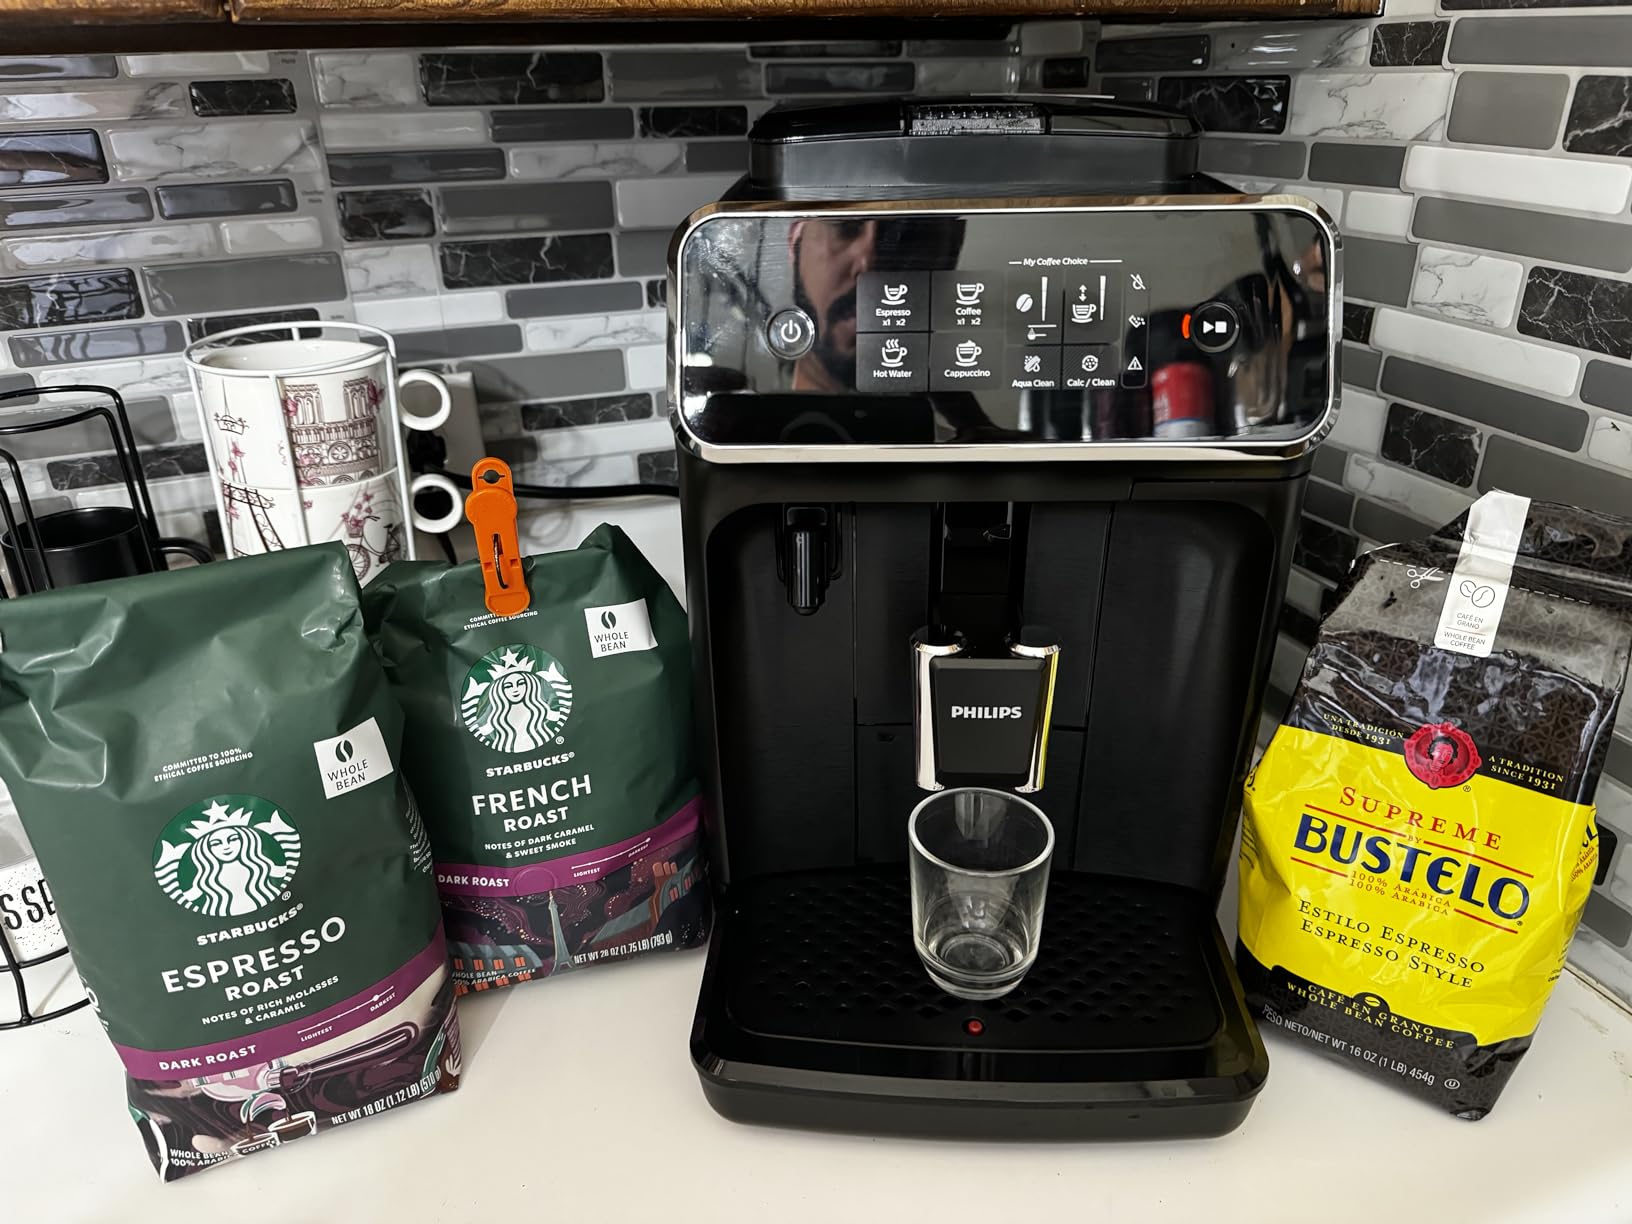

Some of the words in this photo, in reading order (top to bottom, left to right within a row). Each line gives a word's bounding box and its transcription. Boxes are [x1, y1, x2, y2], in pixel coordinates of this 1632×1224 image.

[1024, 258, 1034, 266] My
[1036, 257, 1061, 266] Coffee
[1062, 257, 1088, 265] Choice
[875, 308, 911, 318] Espresso
[955, 307, 982, 315] Coffee
[873, 369, 888, 378] Hot
[888, 369, 912, 378] Water
[944, 369, 991, 378] Cappuccino
[1067, 379, 1084, 387] Calc
[1092, 378, 1115, 387] Clean
[1012, 379, 1032, 388] Aqua
[1033, 379, 1054, 387] Clean
[464, 621, 488, 630] ETHICAL
[508, 611, 538, 620] SOURCING
[469, 613, 500, 623] COMMITT
[1457, 612, 1474, 622] CAFÉ
[1457, 620, 1480, 629] GRANO
[594, 632, 629, 643] WHOLE
[600, 641, 626, 652] BEAN
[1444, 631, 1467, 641] WHOLE
[1468, 636, 1486, 646] BEAN
[1450, 640, 1476, 650] COFFEE
[951, 706, 1022, 719] PHILIPS
[1323, 713, 1343, 724] UNA
[1332, 724, 1362, 737] DESDE
[1365, 733, 1391, 745] 1931
[154, 770, 185, 782] ETHICAL
[187, 763, 214, 774] COFFEE
[215, 752, 253, 767] SOURCING
[162, 756, 207, 772] COMMITTED
[209, 753, 219, 761] TO
[221, 747, 242, 758] 100%
[328, 759, 368, 781] WHOLE
[1491, 765, 1525, 780] SINCE
[1528, 776, 1556, 790] 1931
[1500, 757, 1564, 782] TRADITION
[336, 772, 366, 791] BEAN
[472, 774, 592, 816] FRENCH
[503, 806, 569, 833] ROAST
[1339, 786, 1501, 851] SUPREME
[485, 842, 512, 850] NOTES
[528, 834, 552, 845] DARK
[554, 824, 594, 839] CARAMEL
[1407, 834, 1423, 844] BY
[514, 846, 544, 857] SWEET
[546, 838, 576, 851] SMOKE
[574, 868, 600, 878] LIGHTEST
[1293, 813, 1530, 920] BUSTELO
[438, 875, 469, 885] DARK
[472, 876, 510, 887] ROAST
[1352, 871, 1387, 888] 100%
[1395, 884, 1450, 907] ARÁBICA
[1350, 879, 1385, 895] 100%
[1392, 892, 1448, 915] ARABICA
[1298, 900, 1370, 934] ESTILO
[1380, 925, 1485, 973] ESPRESSO
[161, 916, 346, 993] ESPRESSO
[574, 953, 587, 964] NET
[588, 951, 599, 961] WT
[610, 947, 619, 956] OZ
[638, 938, 650, 951] LB)
[650, 933, 665, 949] (793
[1300, 918, 1399, 961] ESPRESSO
[1408, 955, 1472, 988] STYLE
[225, 965, 304, 1001] ROAST
[471, 975, 506, 985] ARABICA
[476, 970, 497, 978] BEAN
[201, 1011, 237, 1025] NOTES
[240, 1006, 255, 1016] OF
[257, 998, 283, 1012] RICH
[286, 976, 339, 1002] MOLASSES
[370, 992, 396, 1012] DARKEST
[1308, 984, 1345, 1005] CAFÉ
[1351, 1002, 1371, 1014] EN
[1378, 1011, 1434, 1036] GRANO
[245, 1017, 254, 1025] &
[256, 1002, 306, 1022] CARAMEL
[1287, 982, 1338, 1011] WHOLE
[1344, 1007, 1385, 1028] BEAN
[1391, 1025, 1457, 1049] COFFEE
[301, 1025, 333, 1042] LIGHTEST
[1262, 1004, 1282, 1025] PESO
[1284, 1019, 1330, 1044] NETO/NET
[1331, 1037, 1348, 1051] WT
[1349, 1045, 1360, 1057] 16
[1363, 1049, 1377, 1064] OZ
[1379, 1056, 1389, 1067] (1
[1390, 1060, 1407, 1076] LB)
[1409, 1068, 1435, 1086] 454g
[159, 1058, 202, 1070] DARK
[205, 1045, 257, 1065] ROAST
[331, 1114, 347, 1125] NET
[348, 1107, 362, 1120] WT
[363, 1104, 374, 1116] 18
[374, 1098, 386, 1112] OZ
[386, 1089, 407, 1108] (1.12
[407, 1082, 420, 1096] LB)
[420, 1073, 435, 1092] (510
[170, 1148, 201, 1159] WHOLE
[202, 1151, 228, 1159] BEAN
[170, 1158, 195, 1167] 100%
